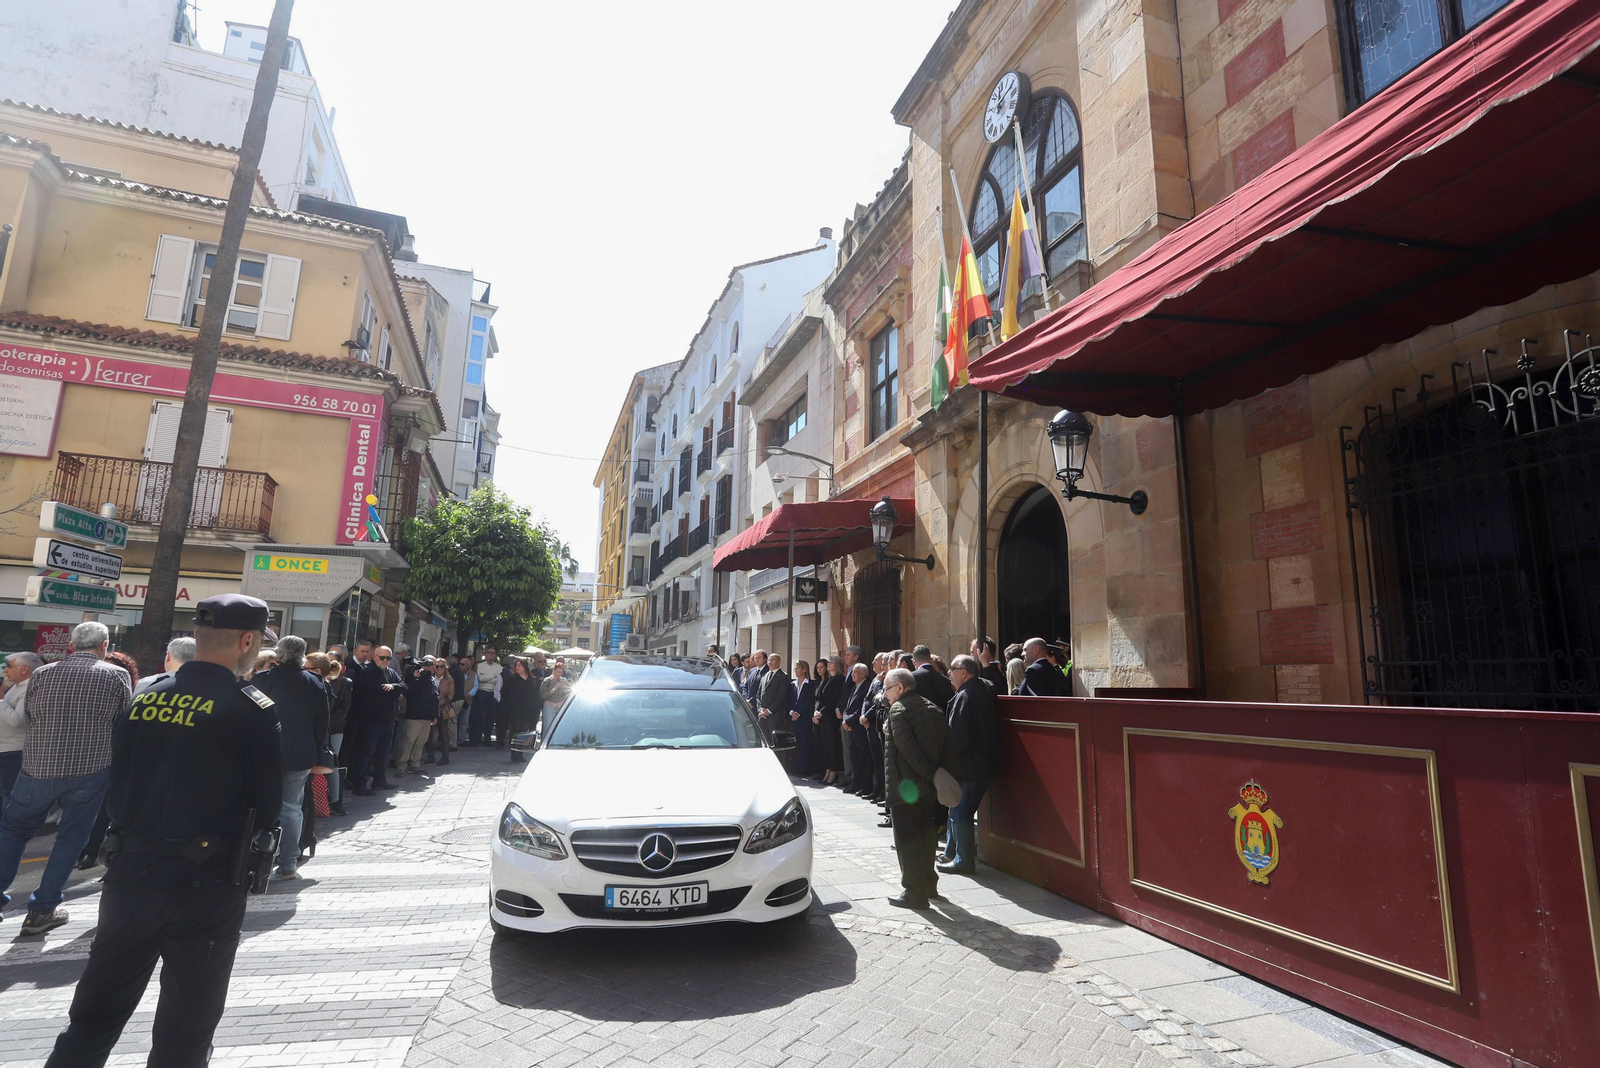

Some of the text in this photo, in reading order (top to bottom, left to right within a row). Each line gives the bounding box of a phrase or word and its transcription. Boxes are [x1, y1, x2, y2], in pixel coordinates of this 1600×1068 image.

[17, 366, 63, 379] sonrisas
[95, 359, 152, 386] ferrer
[293, 394, 377, 415] 956 58 70 01
[352, 424, 371, 477] Dental
[57, 513, 92, 531] Plaza Alta
[61, 557, 119, 576] de estudios superiores
[72, 550, 120, 568] centro universitario
[276, 558, 322, 571] ONCE
[73, 591, 88, 602] Blas
[90, 593, 113, 605] Infante
[131, 691, 214, 714] POLICIA
[129, 706, 195, 727] LOCAL
[619, 886, 701, 906] 6464 KTD
